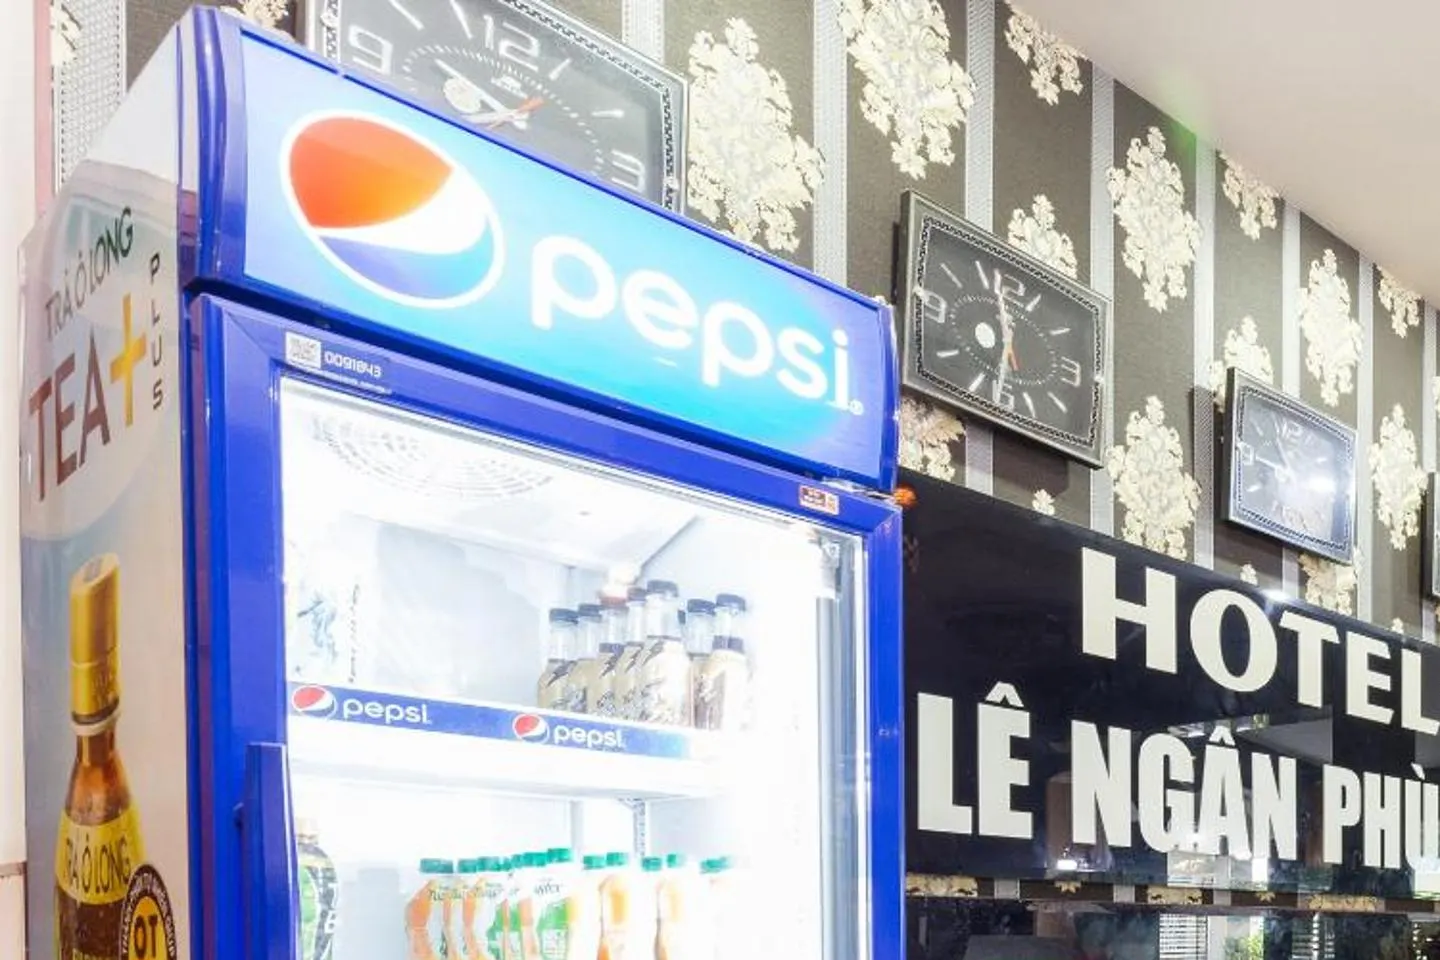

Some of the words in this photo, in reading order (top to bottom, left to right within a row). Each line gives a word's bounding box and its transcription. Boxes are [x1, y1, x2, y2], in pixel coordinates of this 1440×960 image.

[483, 14, 540, 72] 12
[88, 206, 134, 294] LONG
[149, 251, 165, 412] PLUS
[531, 234, 850, 411] pepsi
[1081, 546, 1440, 737] HOTEL
[342, 697, 429, 726] pepsi
[553, 723, 625, 751] pepsi
[917, 682, 1034, 841] LÊ
[1070, 719, 1298, 862] NGÂN
